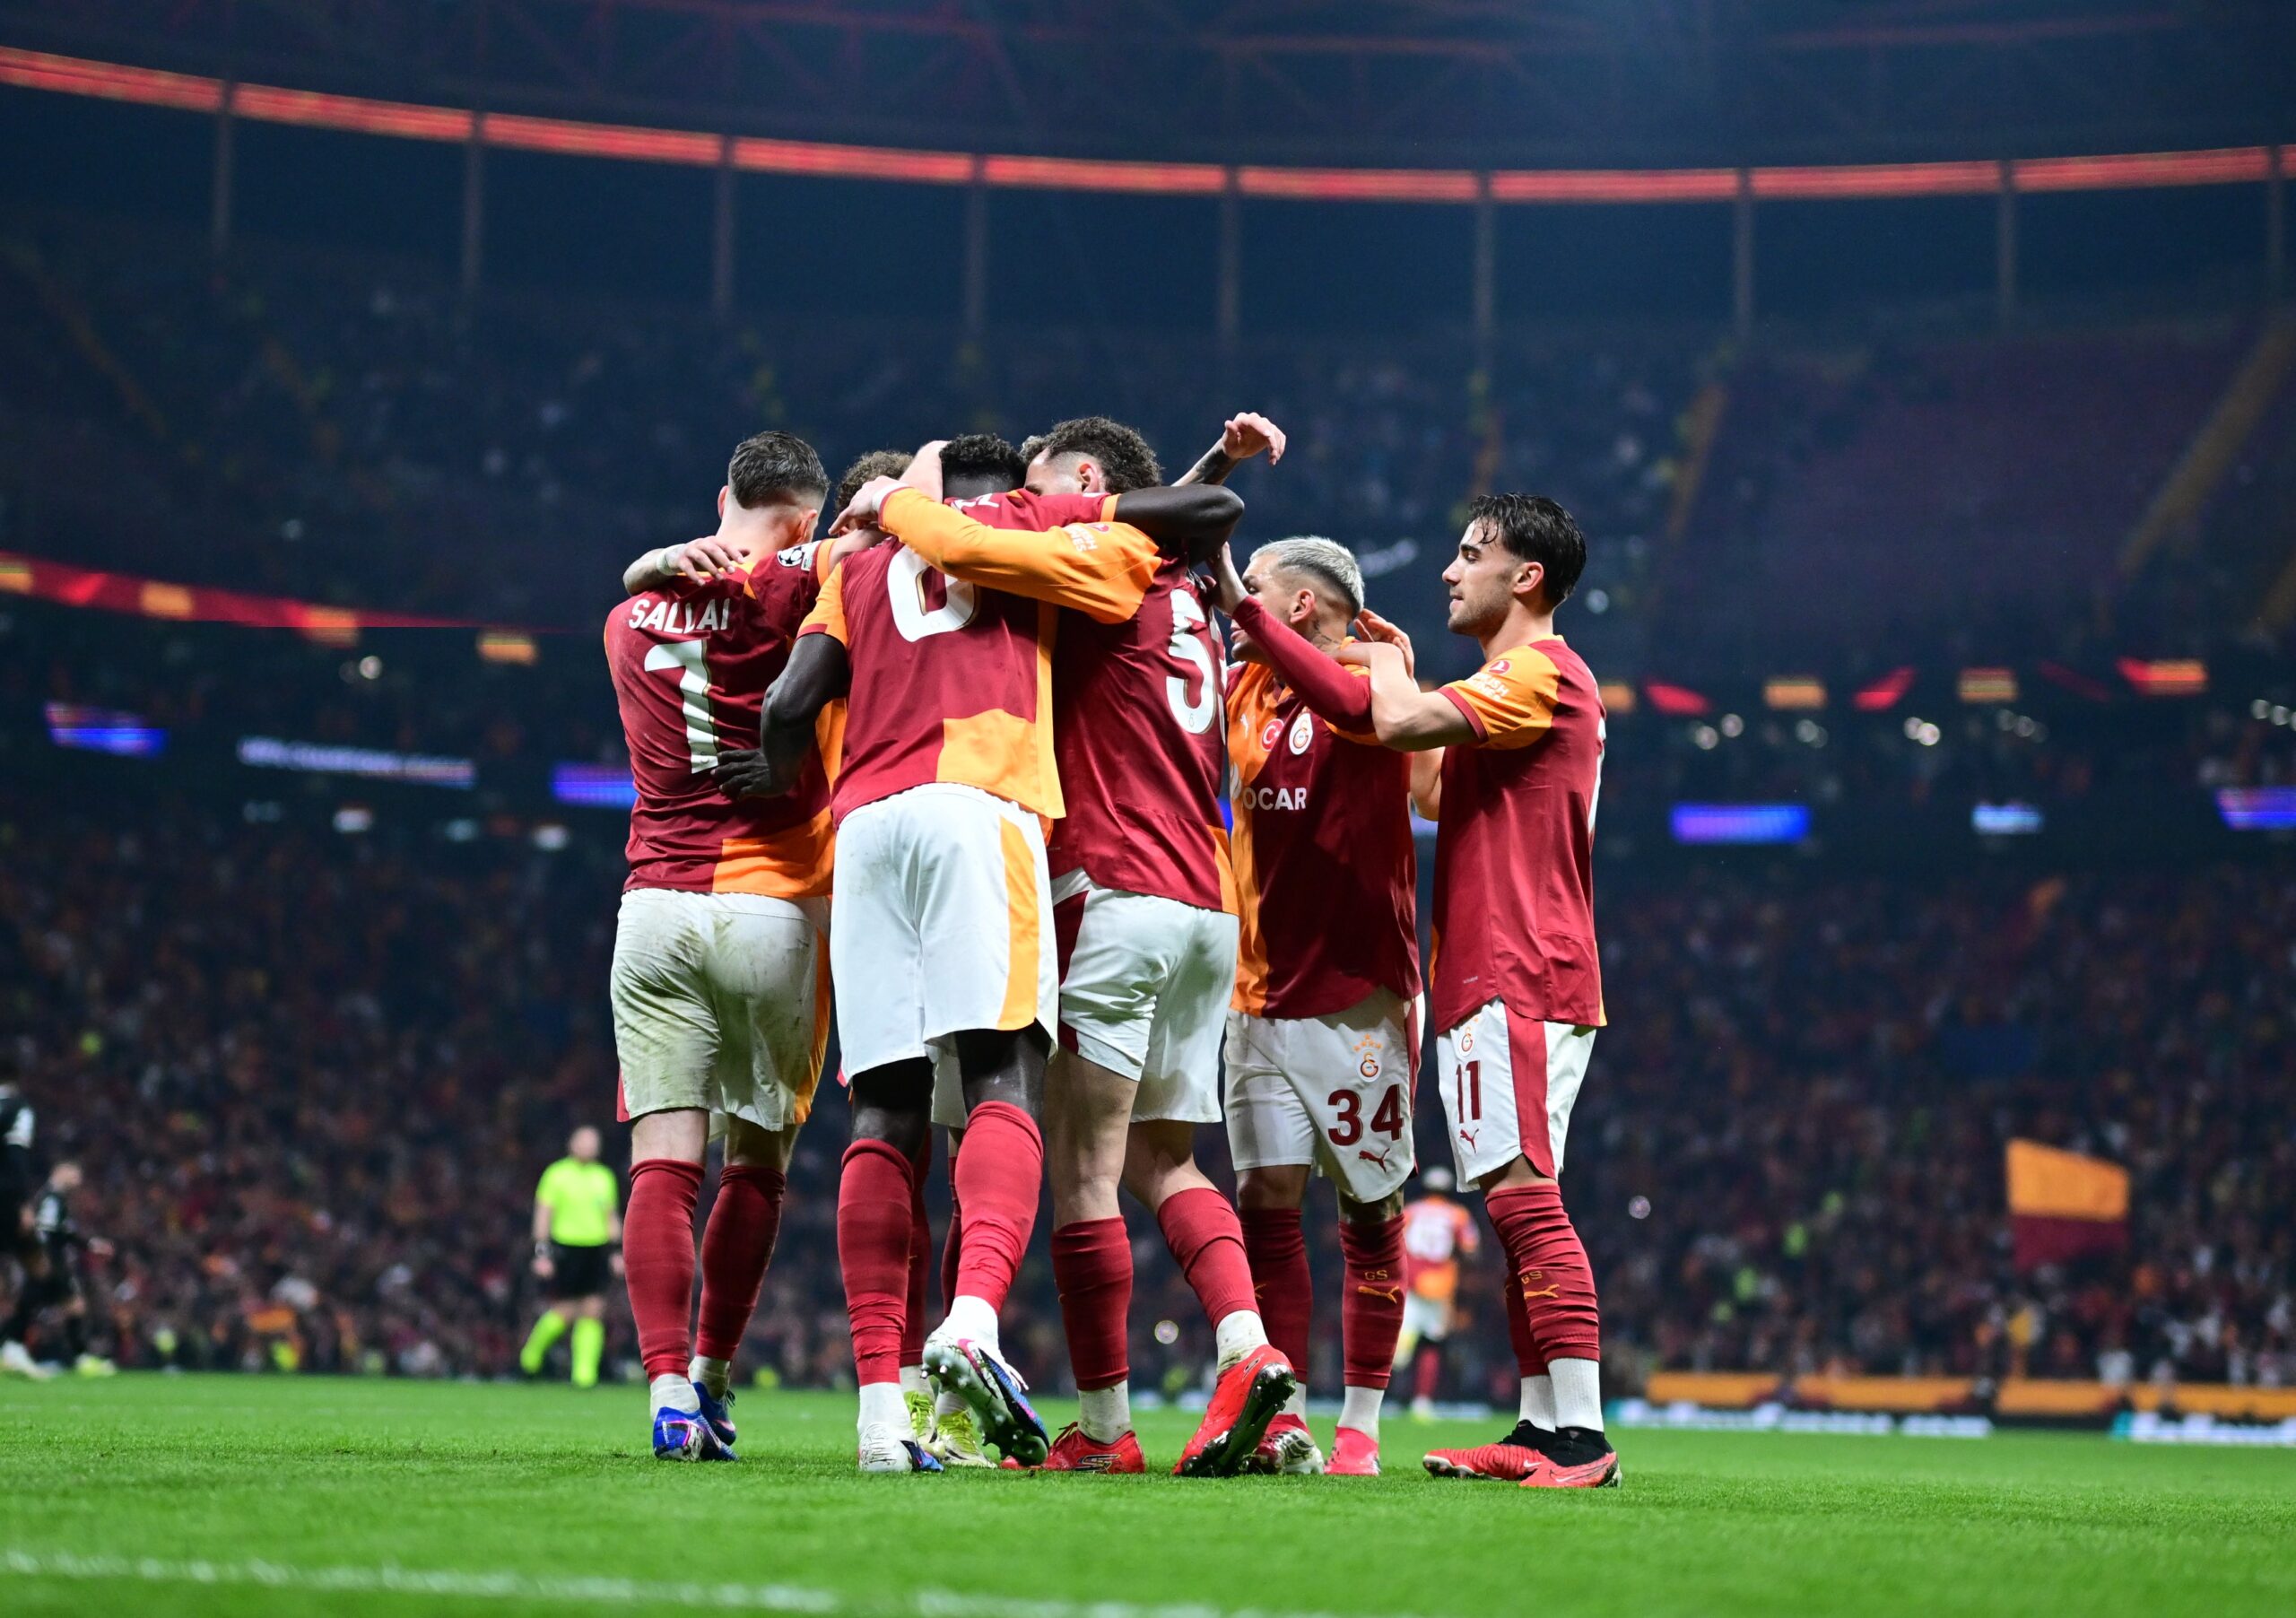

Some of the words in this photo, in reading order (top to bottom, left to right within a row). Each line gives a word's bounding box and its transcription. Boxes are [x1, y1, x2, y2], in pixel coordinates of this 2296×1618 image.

[629, 597, 730, 634] SALLAI
[1327, 1083, 1405, 1147] 34
[1456, 1059, 1483, 1125] 11
[1364, 1269, 1388, 1281] GS
